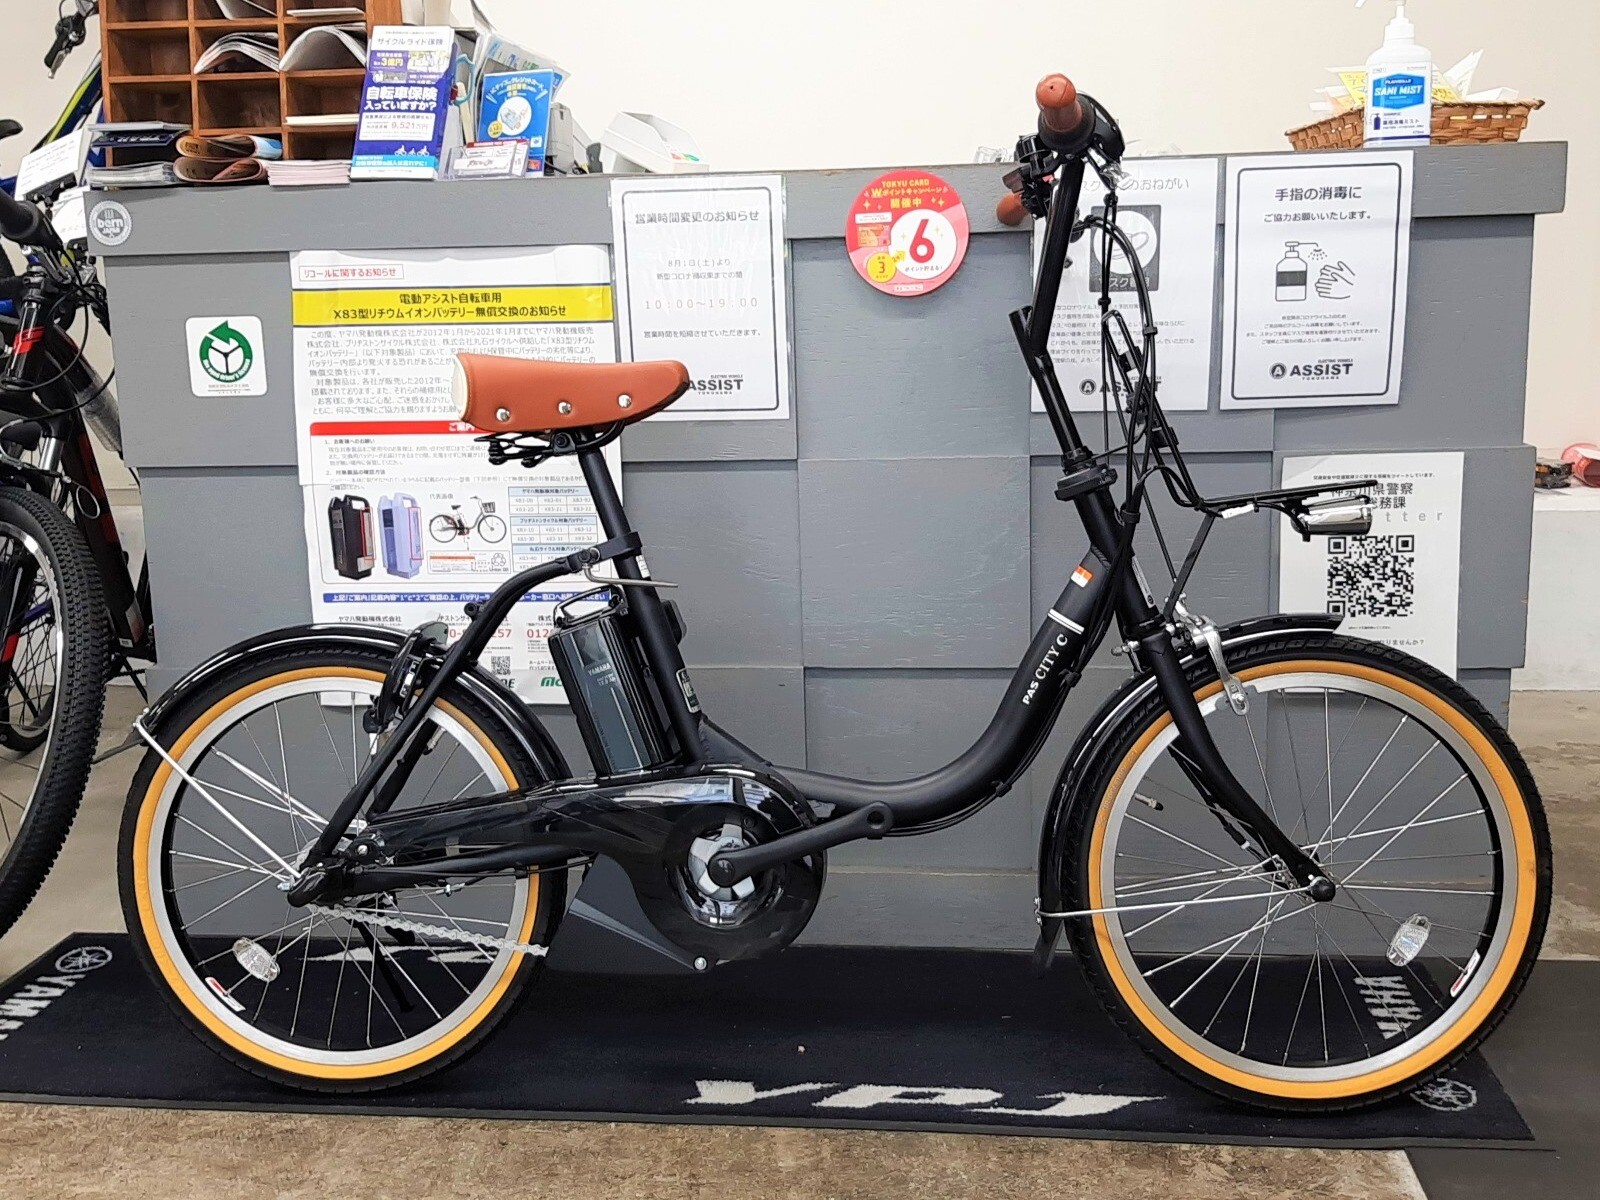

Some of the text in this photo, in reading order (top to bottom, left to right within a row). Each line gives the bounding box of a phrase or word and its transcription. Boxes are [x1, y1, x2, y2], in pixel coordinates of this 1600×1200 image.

[366, 85, 438, 101] 自転車保険
[1374, 84, 1423, 96] SANI MIST
[364, 100, 437, 111] 入っていますか?
[881, 178, 930, 188] TOKYU CARD
[1274, 186, 1363, 202] 手指の消毒に
[890, 197, 922, 209] 開催中
[635, 210, 760, 224] 営業時間変更のお知らせ
[1263, 210, 1372, 223] ご協力お願いいたします。
[909, 218, 935, 264] 6
[304, 267, 397, 279] リコールに関するお知らせ
[878, 261, 886, 274] 3
[400, 292, 502, 305] 電動アシスト自転車用
[333, 305, 567, 320] X83型リチウムイオンバッテリー無償交換のお知らせ
[1289, 363, 1354, 377] ASSIST
[688, 378, 744, 391] ASSIST
[526, 628, 552, 639] 012
[588, 662, 611, 676] YAMAHA
[1022, 633, 1068, 705] PAS CITY C
